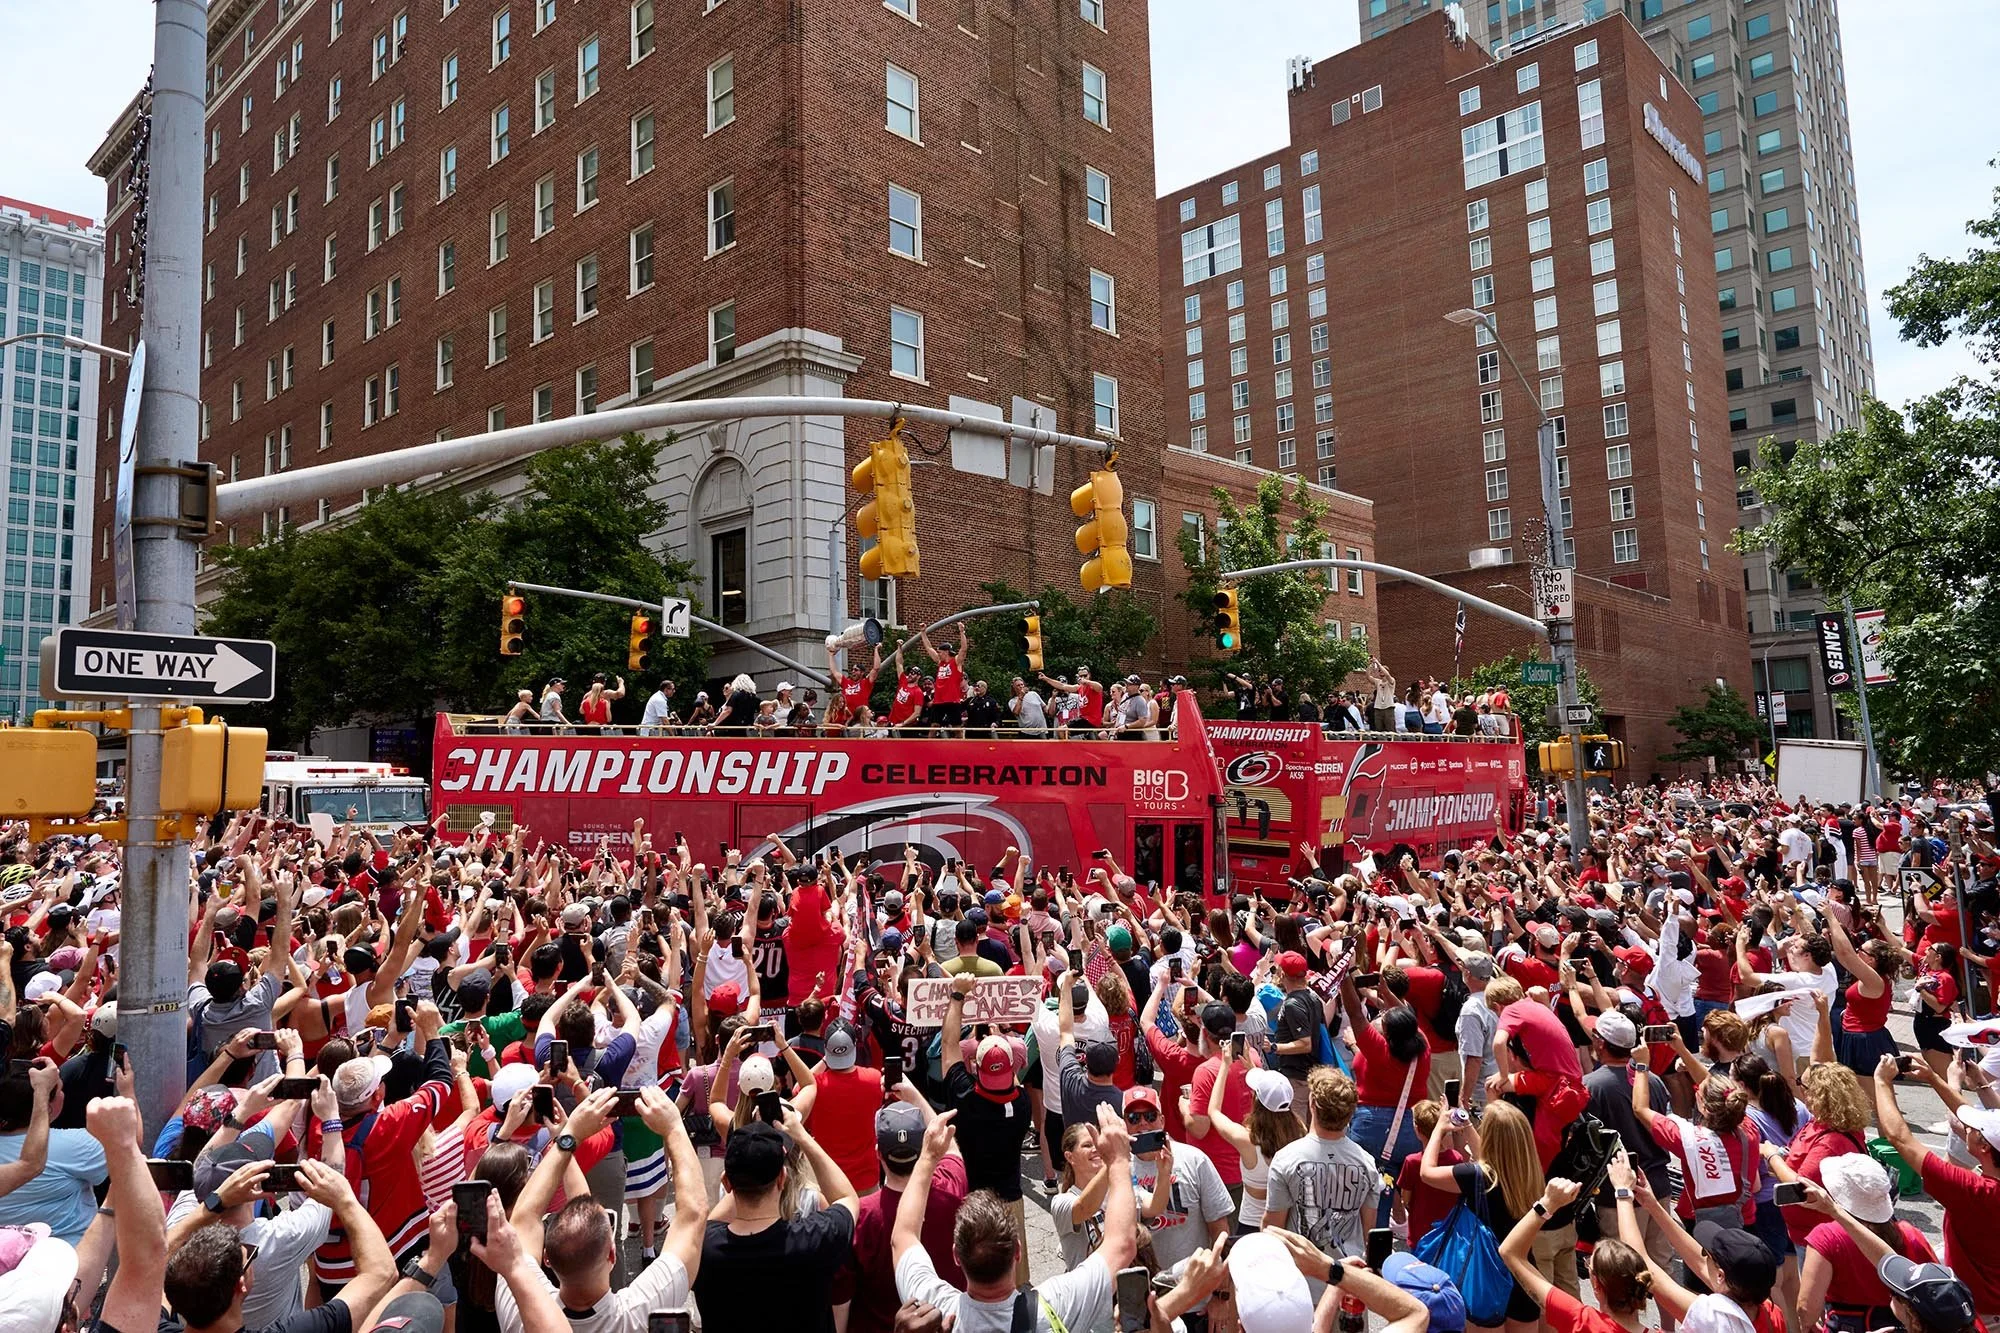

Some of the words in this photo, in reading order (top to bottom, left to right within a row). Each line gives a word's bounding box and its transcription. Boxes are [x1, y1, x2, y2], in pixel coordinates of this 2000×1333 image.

[1546, 572, 1562, 582] NO
[1543, 584, 1566, 592] URN
[1553, 594, 1571, 603] RED
[665, 625, 686, 634] ONLY
[1822, 620, 1844, 670] CANES
[84, 650, 143, 675] ONE
[155, 654, 214, 678] WAY
[1527, 666, 1553, 684] Salisbury
[1569, 710, 1577, 719] ONE
[1578, 711, 1586, 719] WAY
[1207, 726, 1311, 742] CHAMPIONSHIP
[1223, 740, 1288, 749] CELEBRATION
[440, 748, 850, 795] CHAMPIONSHIP
[1285, 763, 1312, 771] Spectrum
[1314, 762, 1343, 774] SIREN
[861, 763, 1107, 787] CELEBRATION
[1133, 769, 1165, 786] BIG
[1133, 786, 1165, 801] BUS
[1143, 801, 1178, 811] TOURS
[1385, 793, 1494, 832] CHAMPIONSHIP
[568, 831, 636, 845] SIREN
[752, 947, 783, 978] 20
[913, 981, 1019, 1003] CHAOTTE
[961, 997, 1037, 1019] CANES
[891, 1022, 932, 1036] SVECHN
[1699, 1146, 1721, 1179] ROCK
